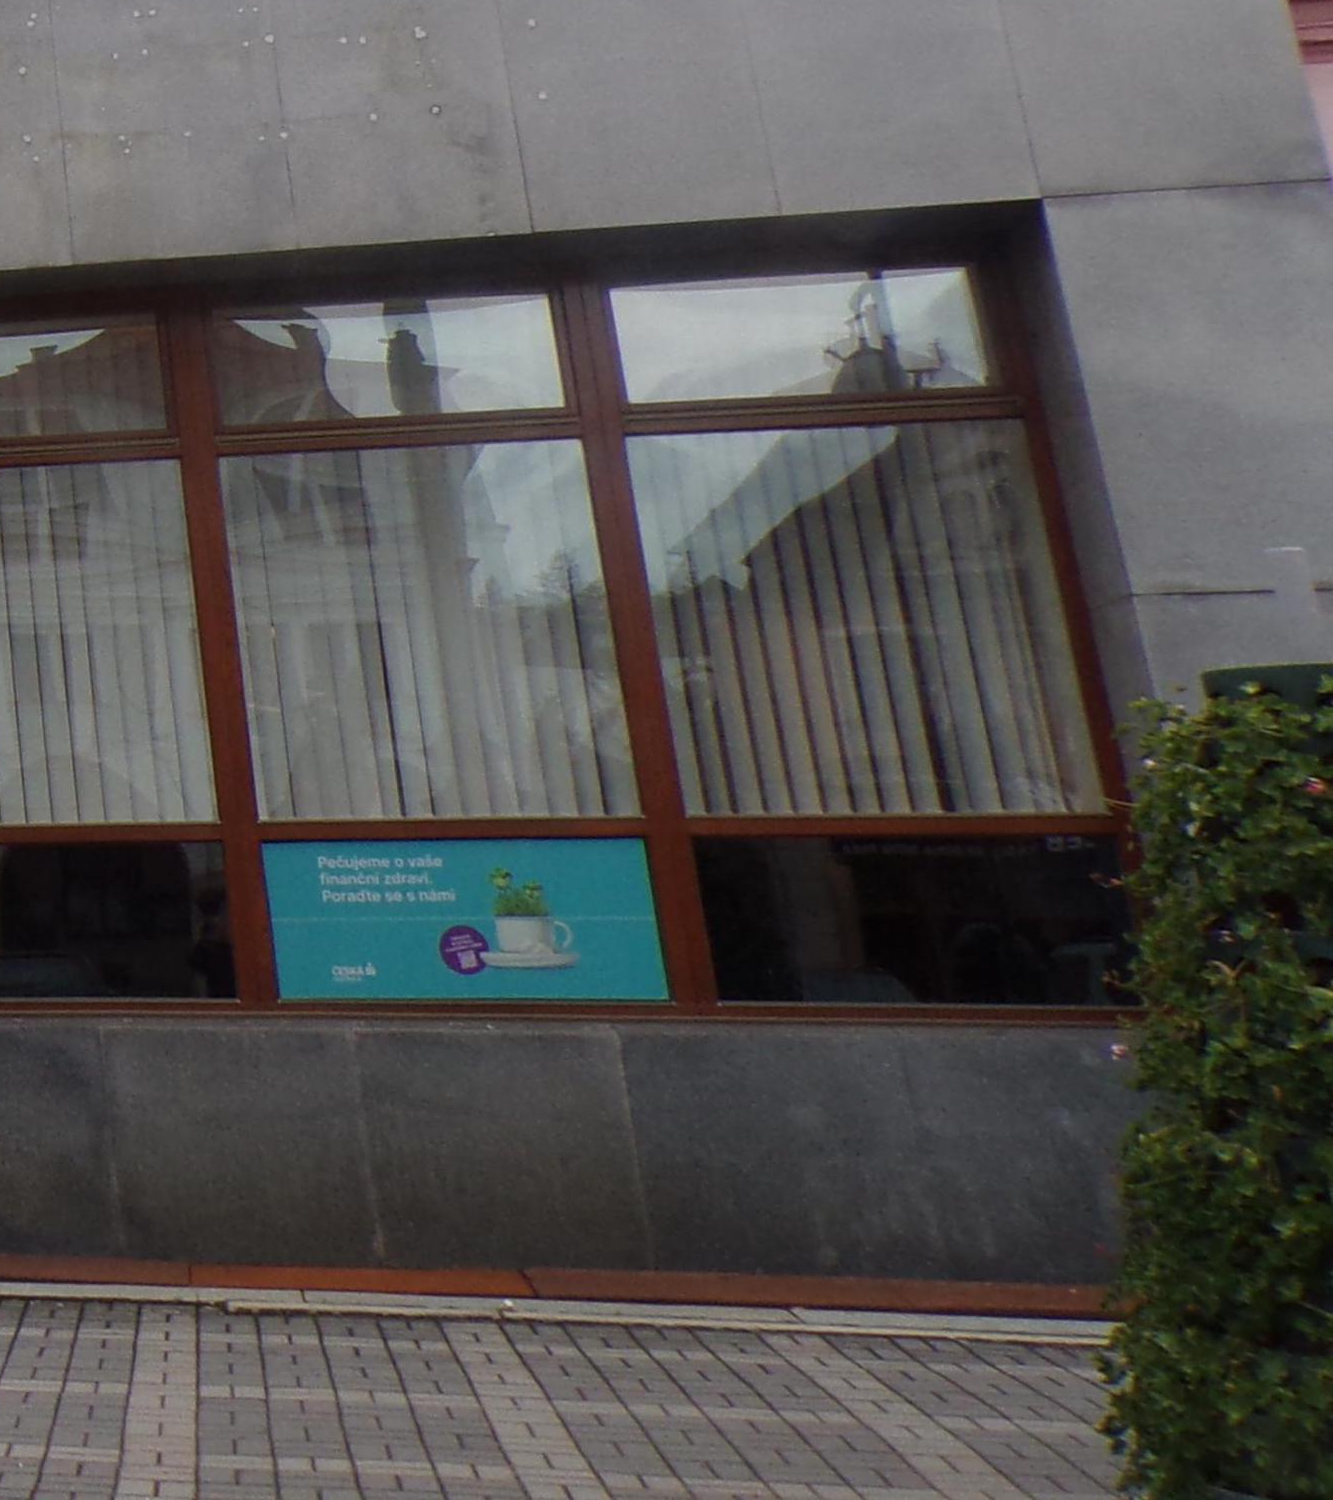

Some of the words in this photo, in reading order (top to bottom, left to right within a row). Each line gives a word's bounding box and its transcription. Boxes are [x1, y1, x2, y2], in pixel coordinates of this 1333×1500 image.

[317, 855, 390, 871] Pečujeme
[394, 858, 404, 868] o
[407, 853, 443, 868] vaše
[384, 890, 403, 902] se
